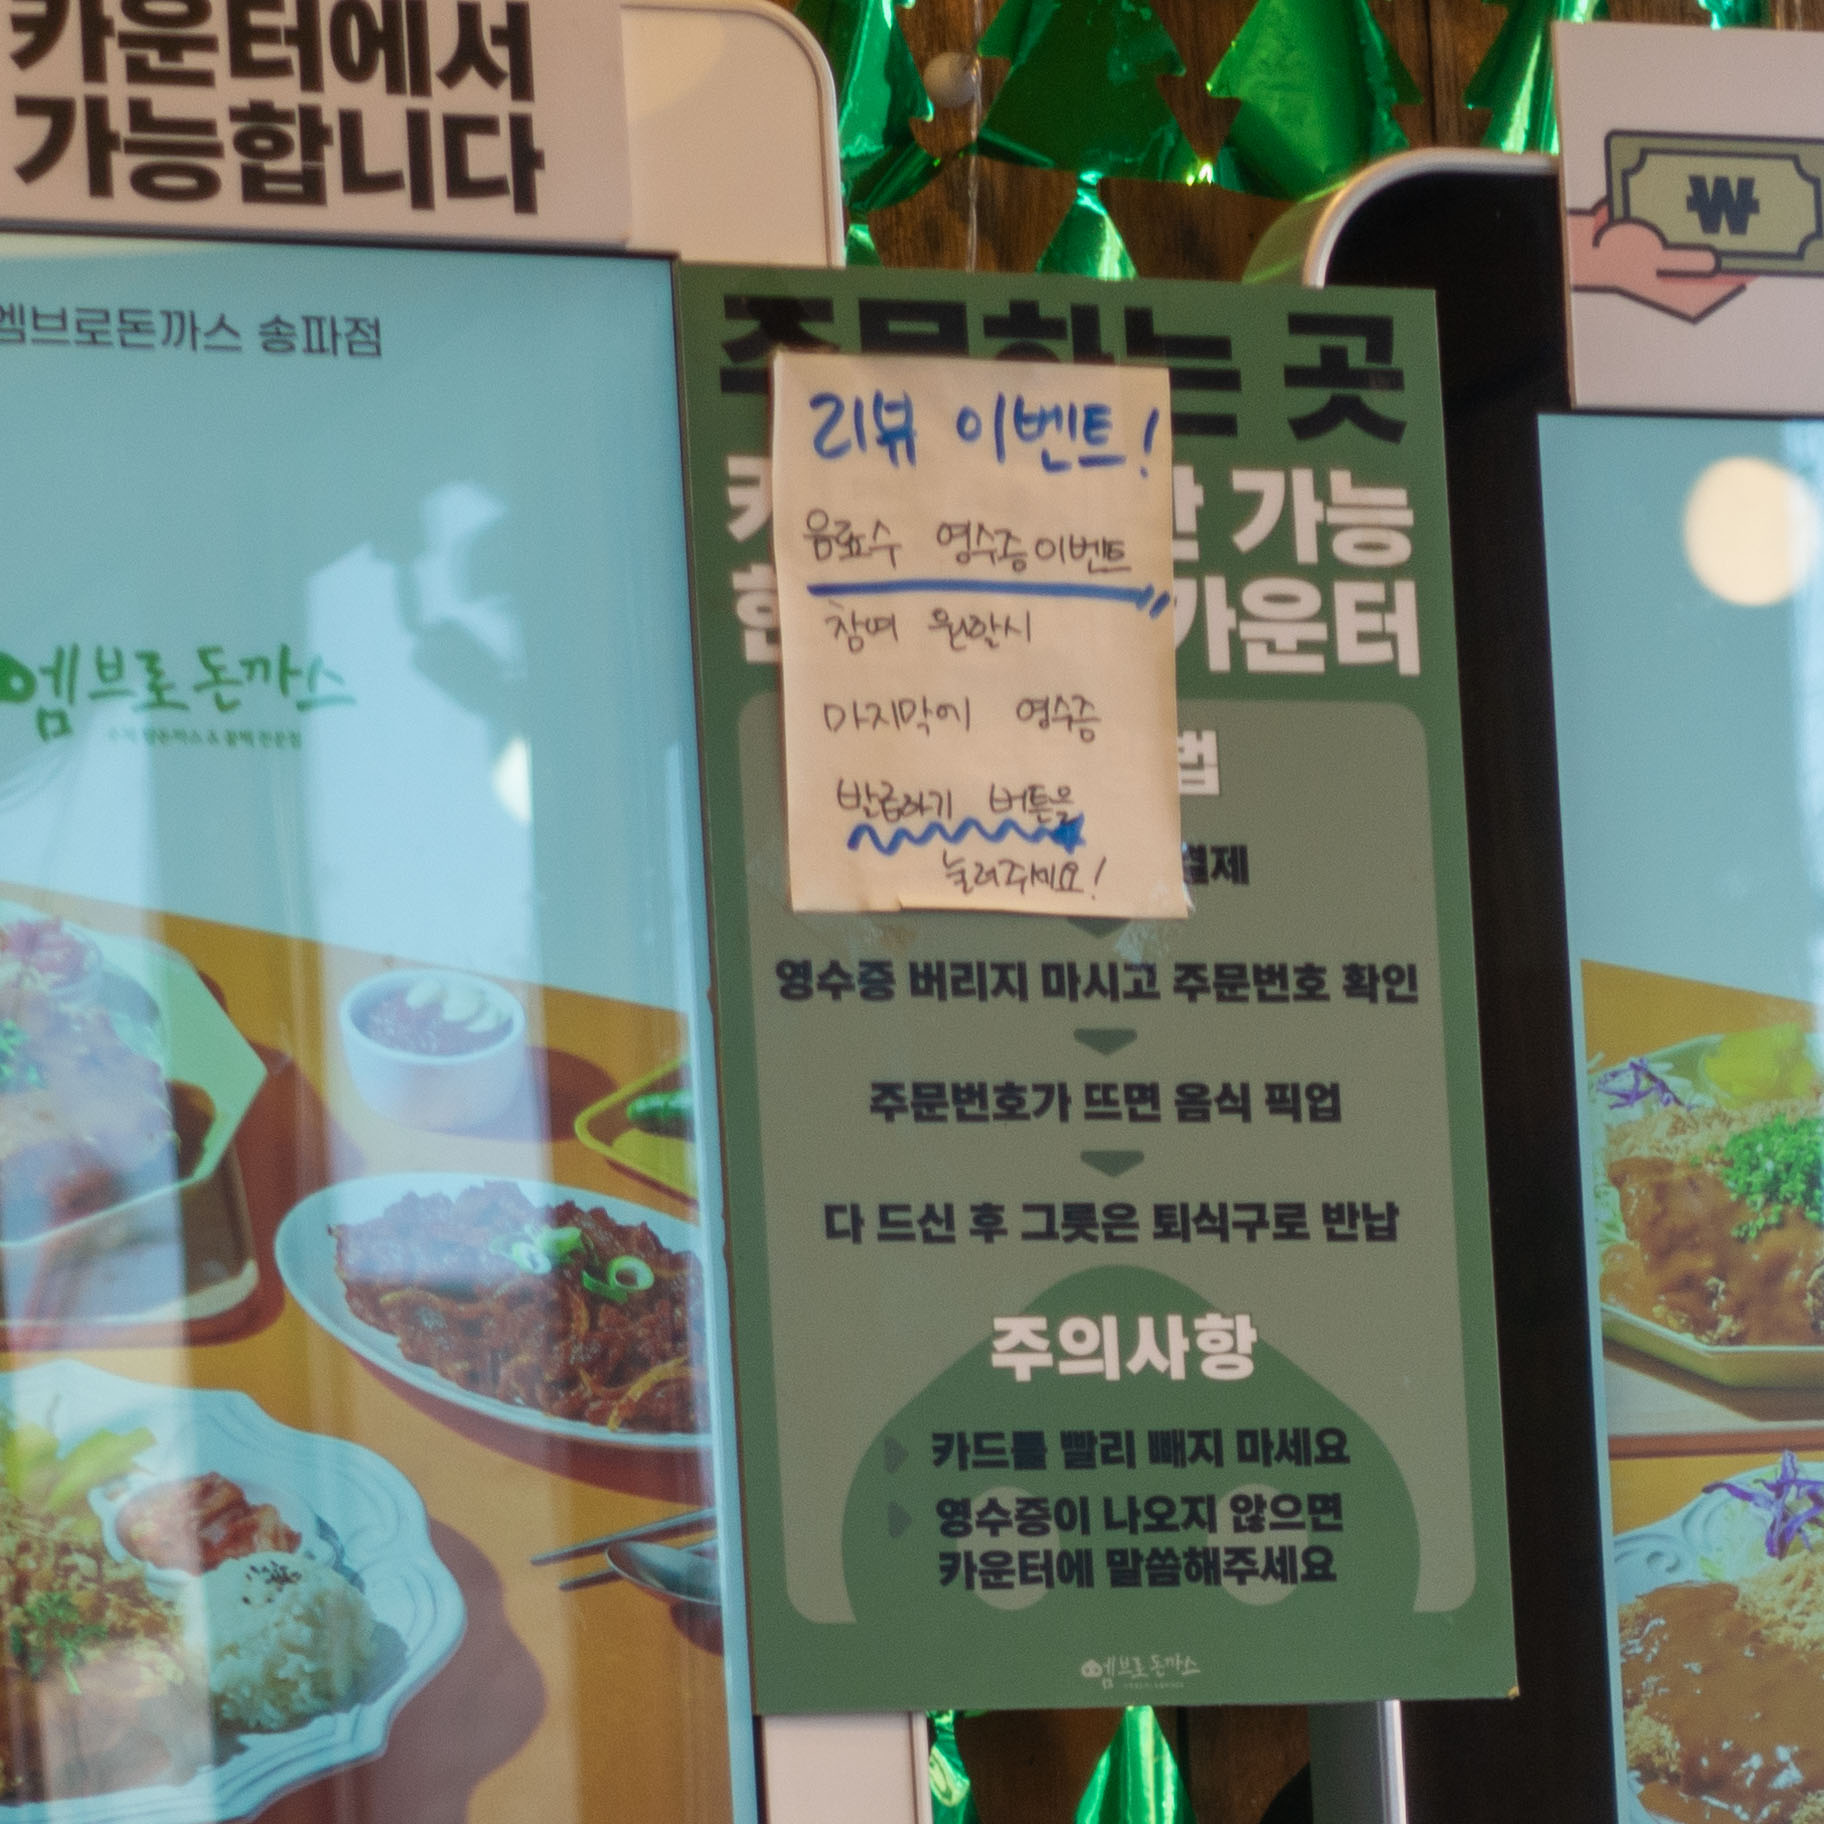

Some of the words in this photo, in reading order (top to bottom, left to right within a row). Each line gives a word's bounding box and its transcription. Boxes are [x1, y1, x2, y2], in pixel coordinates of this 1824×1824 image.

[9, 0, 535, 102] 카운터에서
[13, 95, 545, 214] 가능합니다
[258, 310, 382, 358] 송파점
[1283, 311, 1407, 444] 곳
[810, 391, 917, 468] 리뷰
[957, 392, 1161, 478] 이벤트!
[803, 508, 902, 569] 음료수
[936, 520, 1028, 572] 영수증
[1232, 468, 1415, 568] 가능
[826, 600, 898, 654] 참여
[824, 696, 971, 737] 마지막에
[1016, 694, 1101, 743] 영수증
[837, 778, 952, 823] 발급하기
[775, 958, 896, 1003] 영수증
[908, 960, 1029, 1003] 버리지
[1042, 962, 1157, 1004] 마시고
[1173, 961, 1330, 1005] 주문번호
[1342, 963, 1419, 1005] 확인
[868, 1081, 1071, 1125] 주문번호가
[1083, 1081, 1161, 1123] 뜨면
[1174, 1083, 1252, 1123] 음식
[1264, 1083, 1343, 1123] 픽업
[823, 1203, 864, 1244] 다
[876, 1203, 956, 1244] 드신
[969, 1203, 1008, 1244] 후
[1021, 1203, 1140, 1244] 그릇은
[1152, 1203, 1310, 1244] 퇴식구로
[1322, 1202, 1399, 1243] 반납
[989, 1313, 1258, 1383] 주의사항
[932, 1431, 1048, 1471] 카드를
[1060, 1430, 1136, 1469] 빨리
[1147, 1429, 1224, 1468] 빼지
[1237, 1428, 1351, 1468] 마세요
[935, 1496, 1090, 1540] 영수증이
[1103, 1494, 1217, 1536] 나오지
[1229, 1492, 1343, 1533] 않으면
[939, 1549, 1094, 1590] 카운터에
[1106, 1545, 1337, 1588] 말씀해주세요
